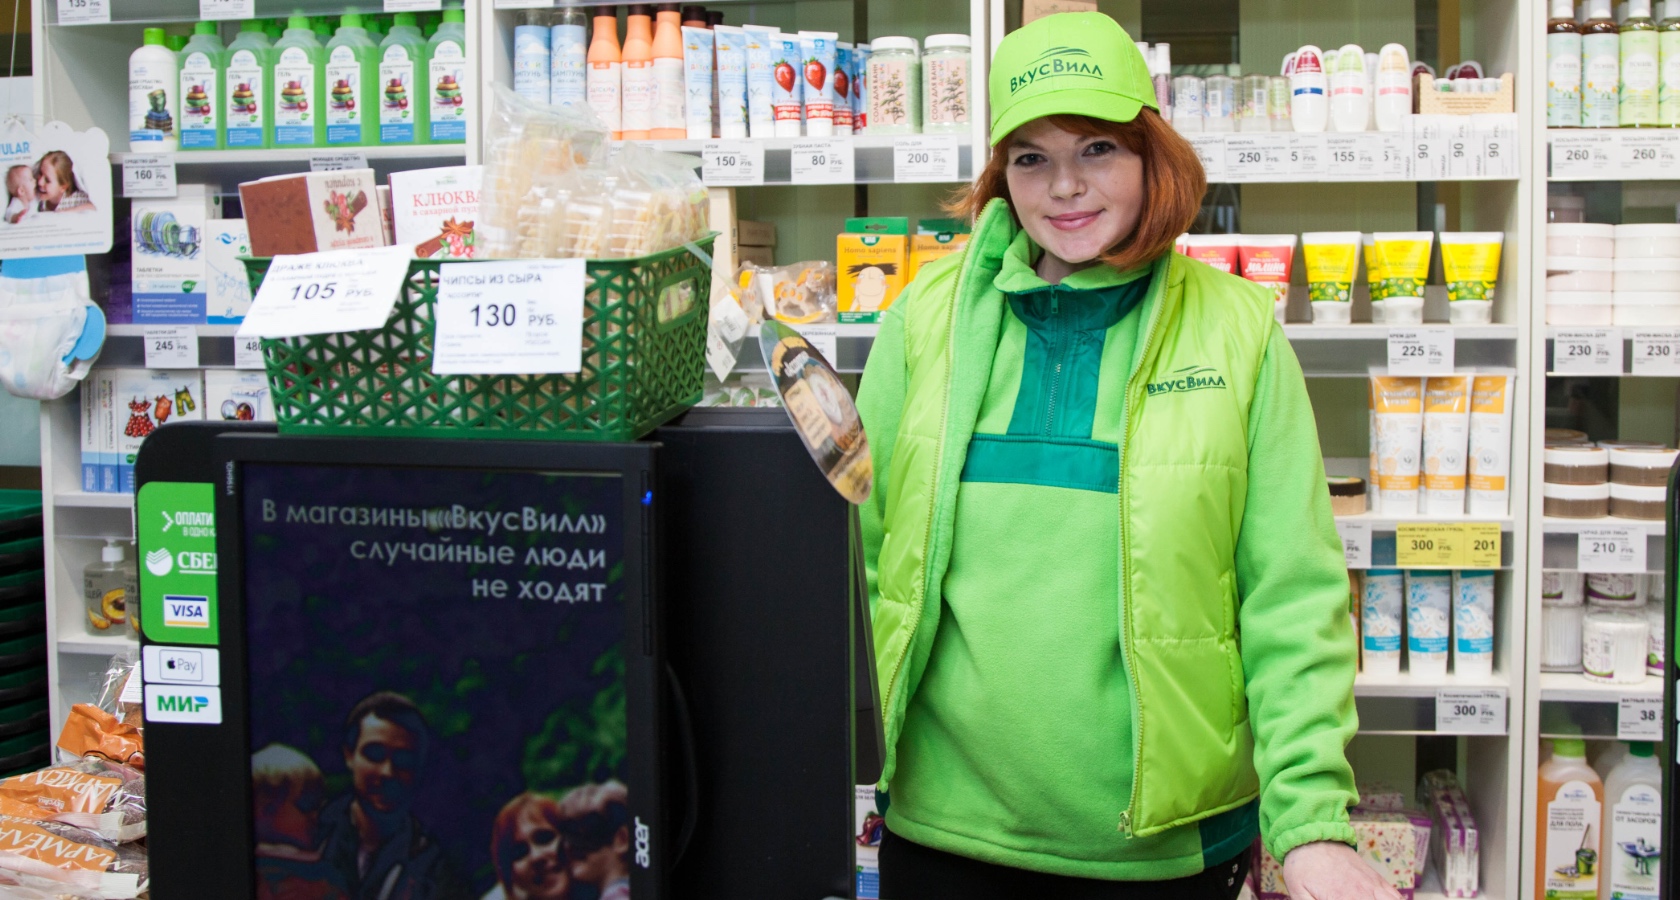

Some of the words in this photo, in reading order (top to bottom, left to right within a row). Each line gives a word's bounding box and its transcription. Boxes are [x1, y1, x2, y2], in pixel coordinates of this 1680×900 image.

[1010, 58, 1103, 93] ВкусВилл
[1334, 151, 1355, 161] 155
[1418, 144, 1429, 159] 90
[1453, 143, 1464, 158] 90
[1488, 143, 1499, 158] 90
[1566, 150, 1589, 160] 260
[1633, 149, 1656, 160] 260
[715, 155, 736, 166] 150
[811, 155, 826, 166] 80
[907, 152, 929, 163] 200
[1239, 152, 1261, 163] 250
[135, 170, 152, 179] 160
[419, 206, 459, 216] сахарной
[868, 247, 897, 255] sapiens
[442, 274, 486, 286] ЧИПСЫ
[489, 273, 504, 284] ИЗ
[507, 273, 542, 284] СЫРА
[291, 282, 337, 301] 105
[345, 288, 374, 298] РУБ.
[470, 303, 516, 327] 130
[527, 313, 558, 326] РУБ.
[155, 341, 173, 351] 245
[246, 341, 263, 351] 480
[1402, 346, 1425, 356] 225
[1569, 345, 1591, 355] 230
[1647, 345, 1670, 355] 230
[1147, 375, 1226, 395] ВкусВилл
[262, 499, 276, 522] В
[286, 504, 427, 528] магазины
[1411, 539, 1434, 550] 300
[1474, 539, 1496, 550] 201
[1593, 542, 1616, 553] 210
[350, 537, 516, 566] случайные
[525, 549, 606, 569] люди
[177, 551, 218, 570] СБЕ
[472, 580, 508, 598] не
[518, 581, 606, 604] ходят
[170, 603, 203, 618] VISA
[177, 658, 197, 674] Pay
[157, 694, 209, 712] МИР
[1454, 705, 1476, 715] 300
[1640, 710, 1656, 721] 38
[634, 815, 650, 868] acer
